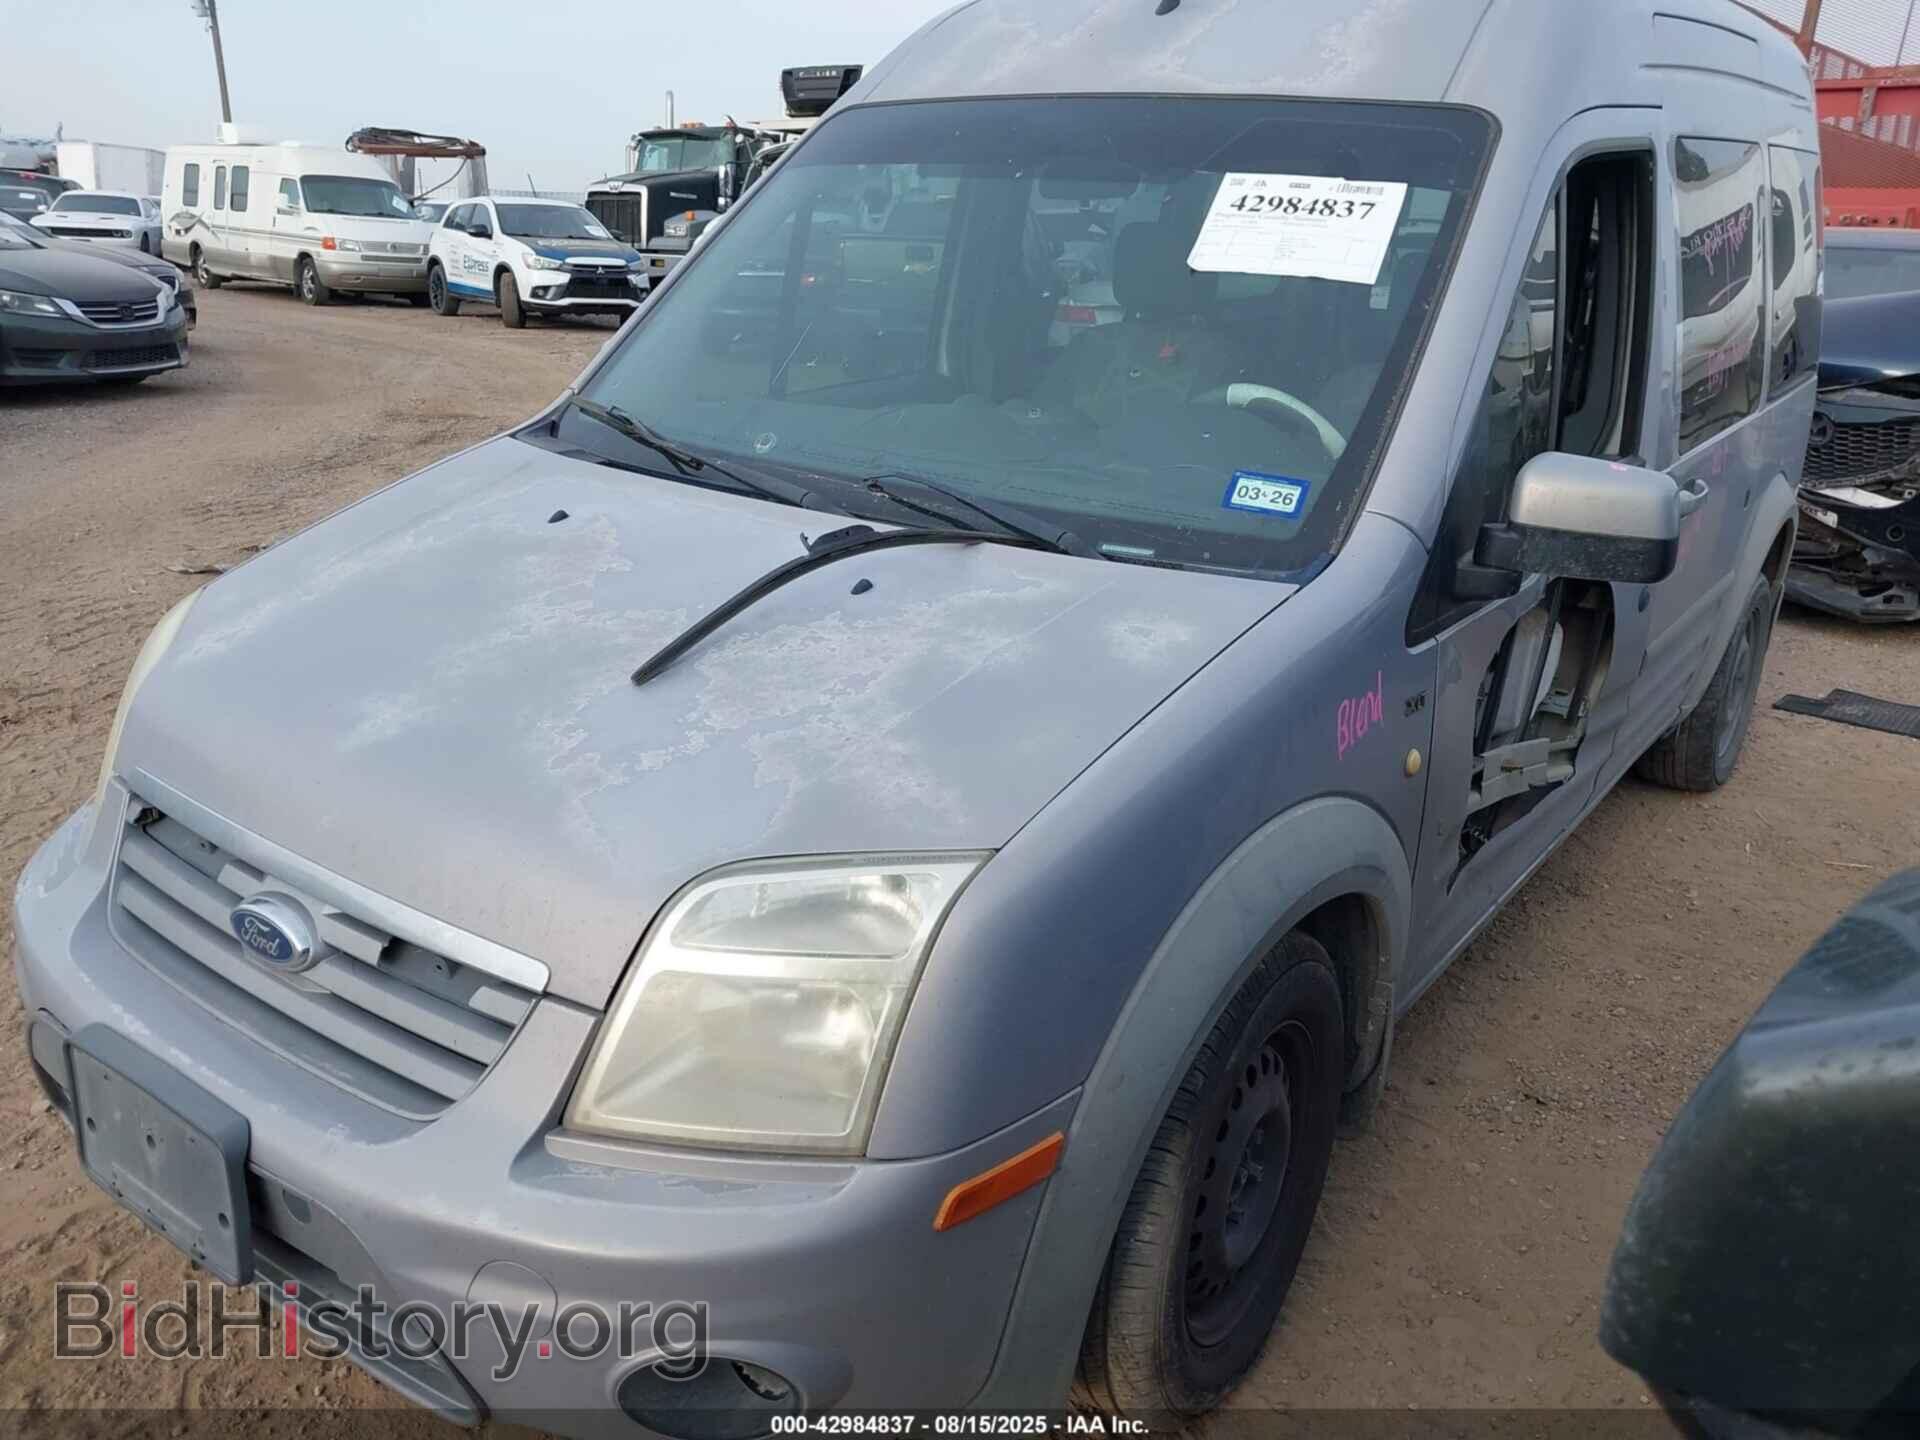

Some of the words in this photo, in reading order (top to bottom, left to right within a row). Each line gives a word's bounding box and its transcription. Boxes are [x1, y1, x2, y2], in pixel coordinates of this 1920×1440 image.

[1230, 194, 1376, 220] 42984837
[1237, 485, 1261, 501] 03
[1270, 490, 1295, 506] 26
[241, 916, 281, 957] Ford
